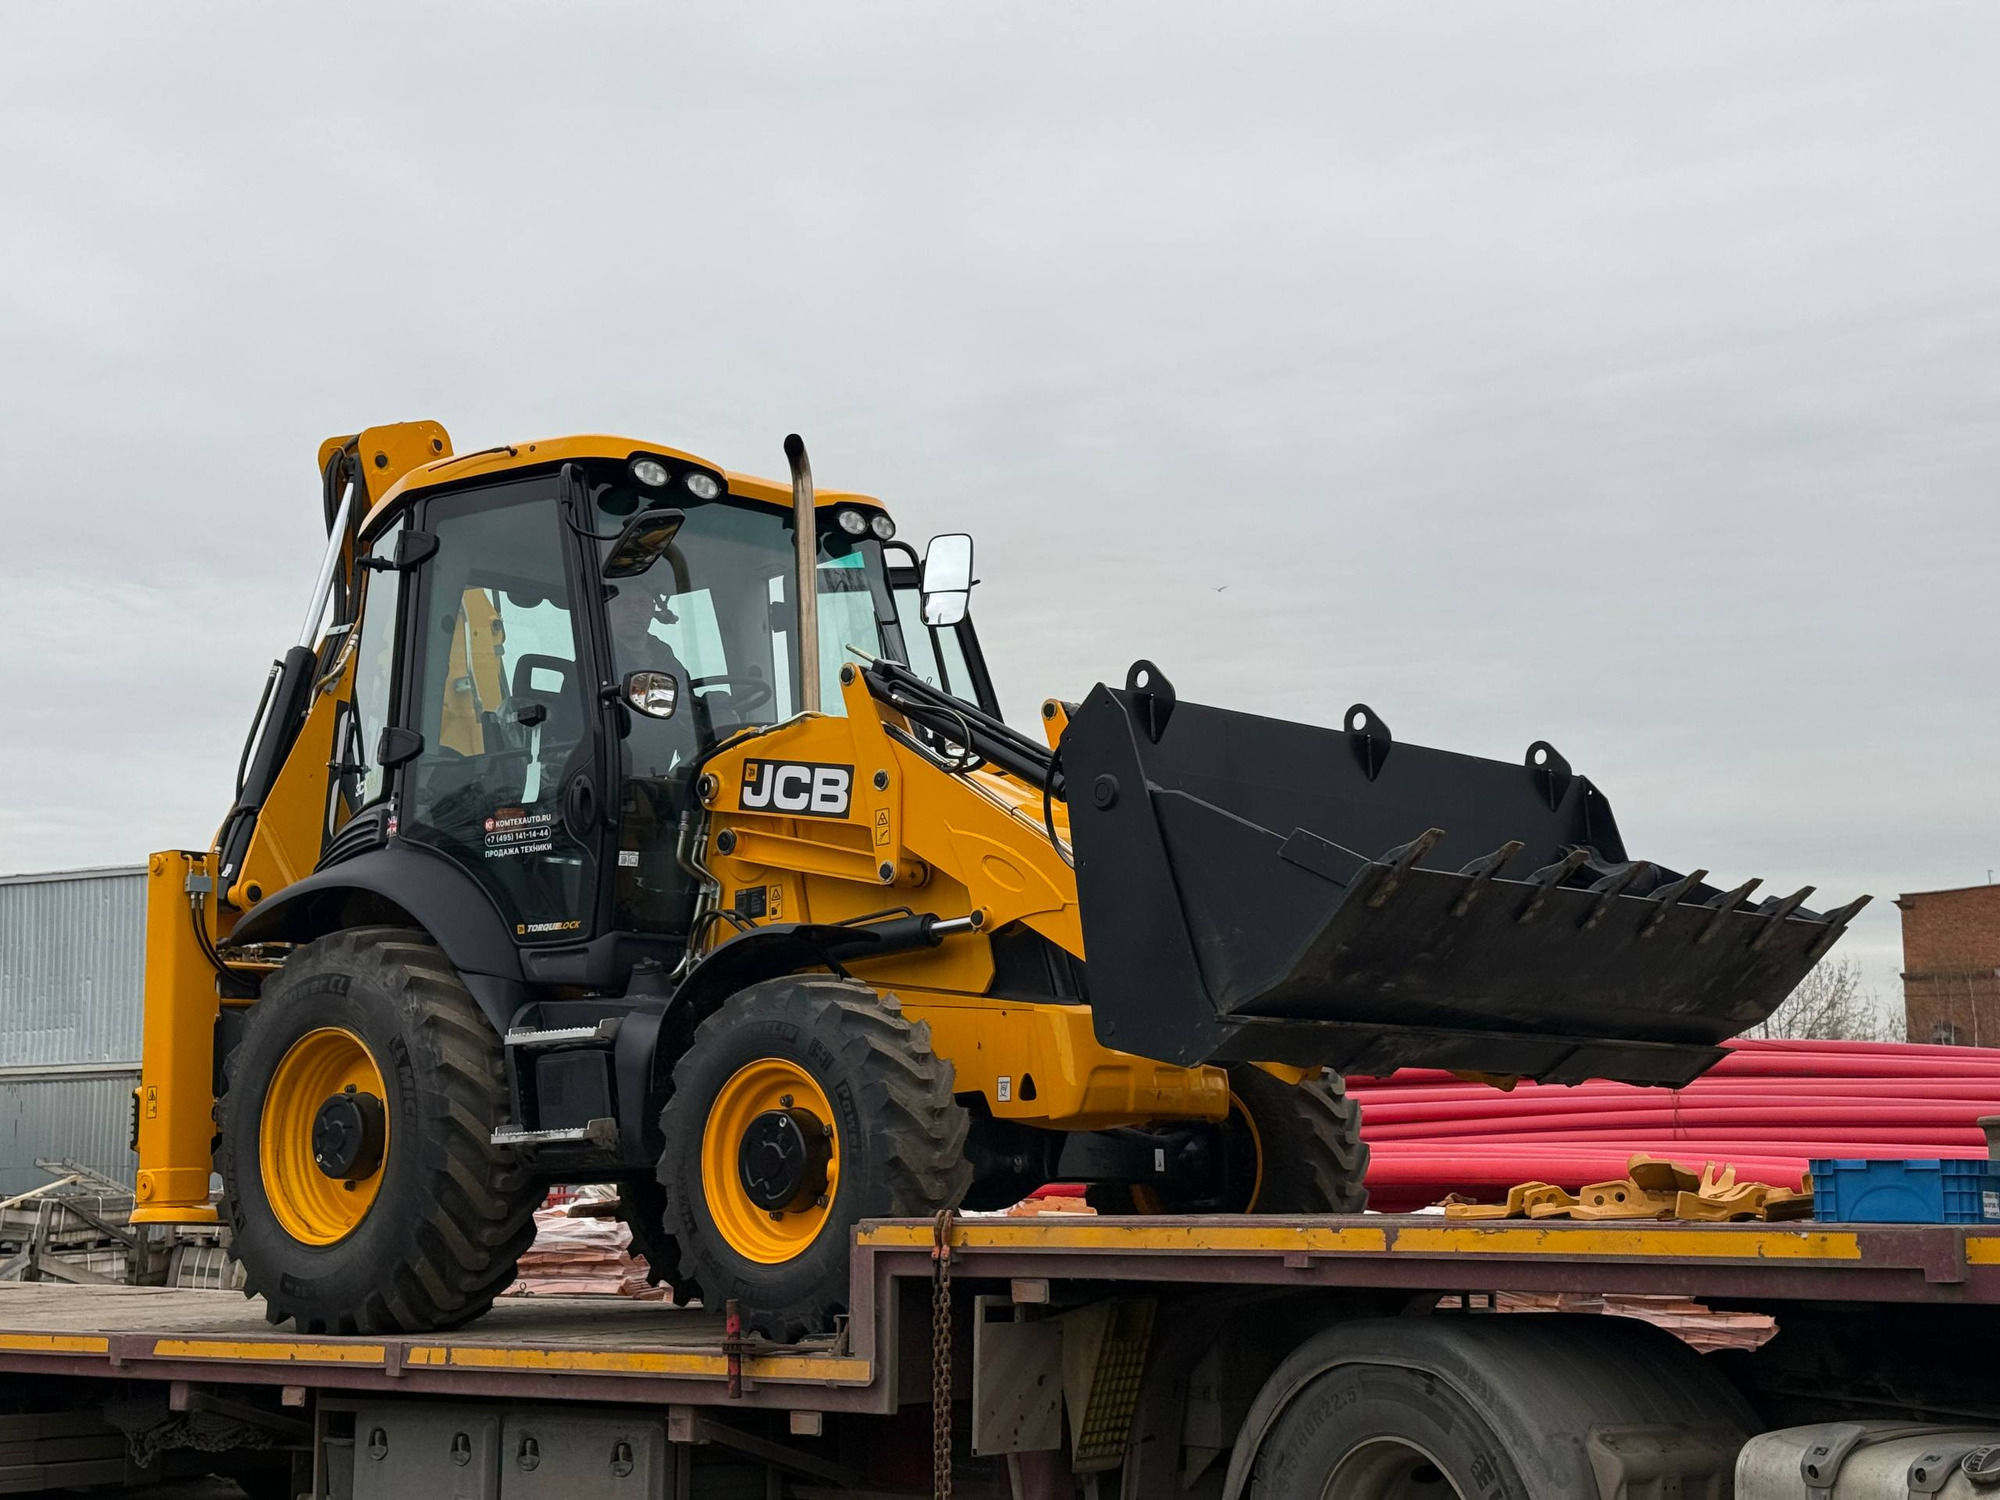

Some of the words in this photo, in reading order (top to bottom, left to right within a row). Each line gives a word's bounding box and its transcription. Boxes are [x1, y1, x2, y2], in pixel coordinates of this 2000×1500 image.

[742, 764, 850, 814] JCB
[495, 813, 552, 828] KOMTEXAUTO.RU
[487, 835, 496, 844] +7
[496, 833, 514, 844] (495)
[515, 828, 549, 840] 141-14-44
[484, 847, 520, 858] ПРОДАЖА
[520, 843, 553, 854] ТЕХНИКИ
